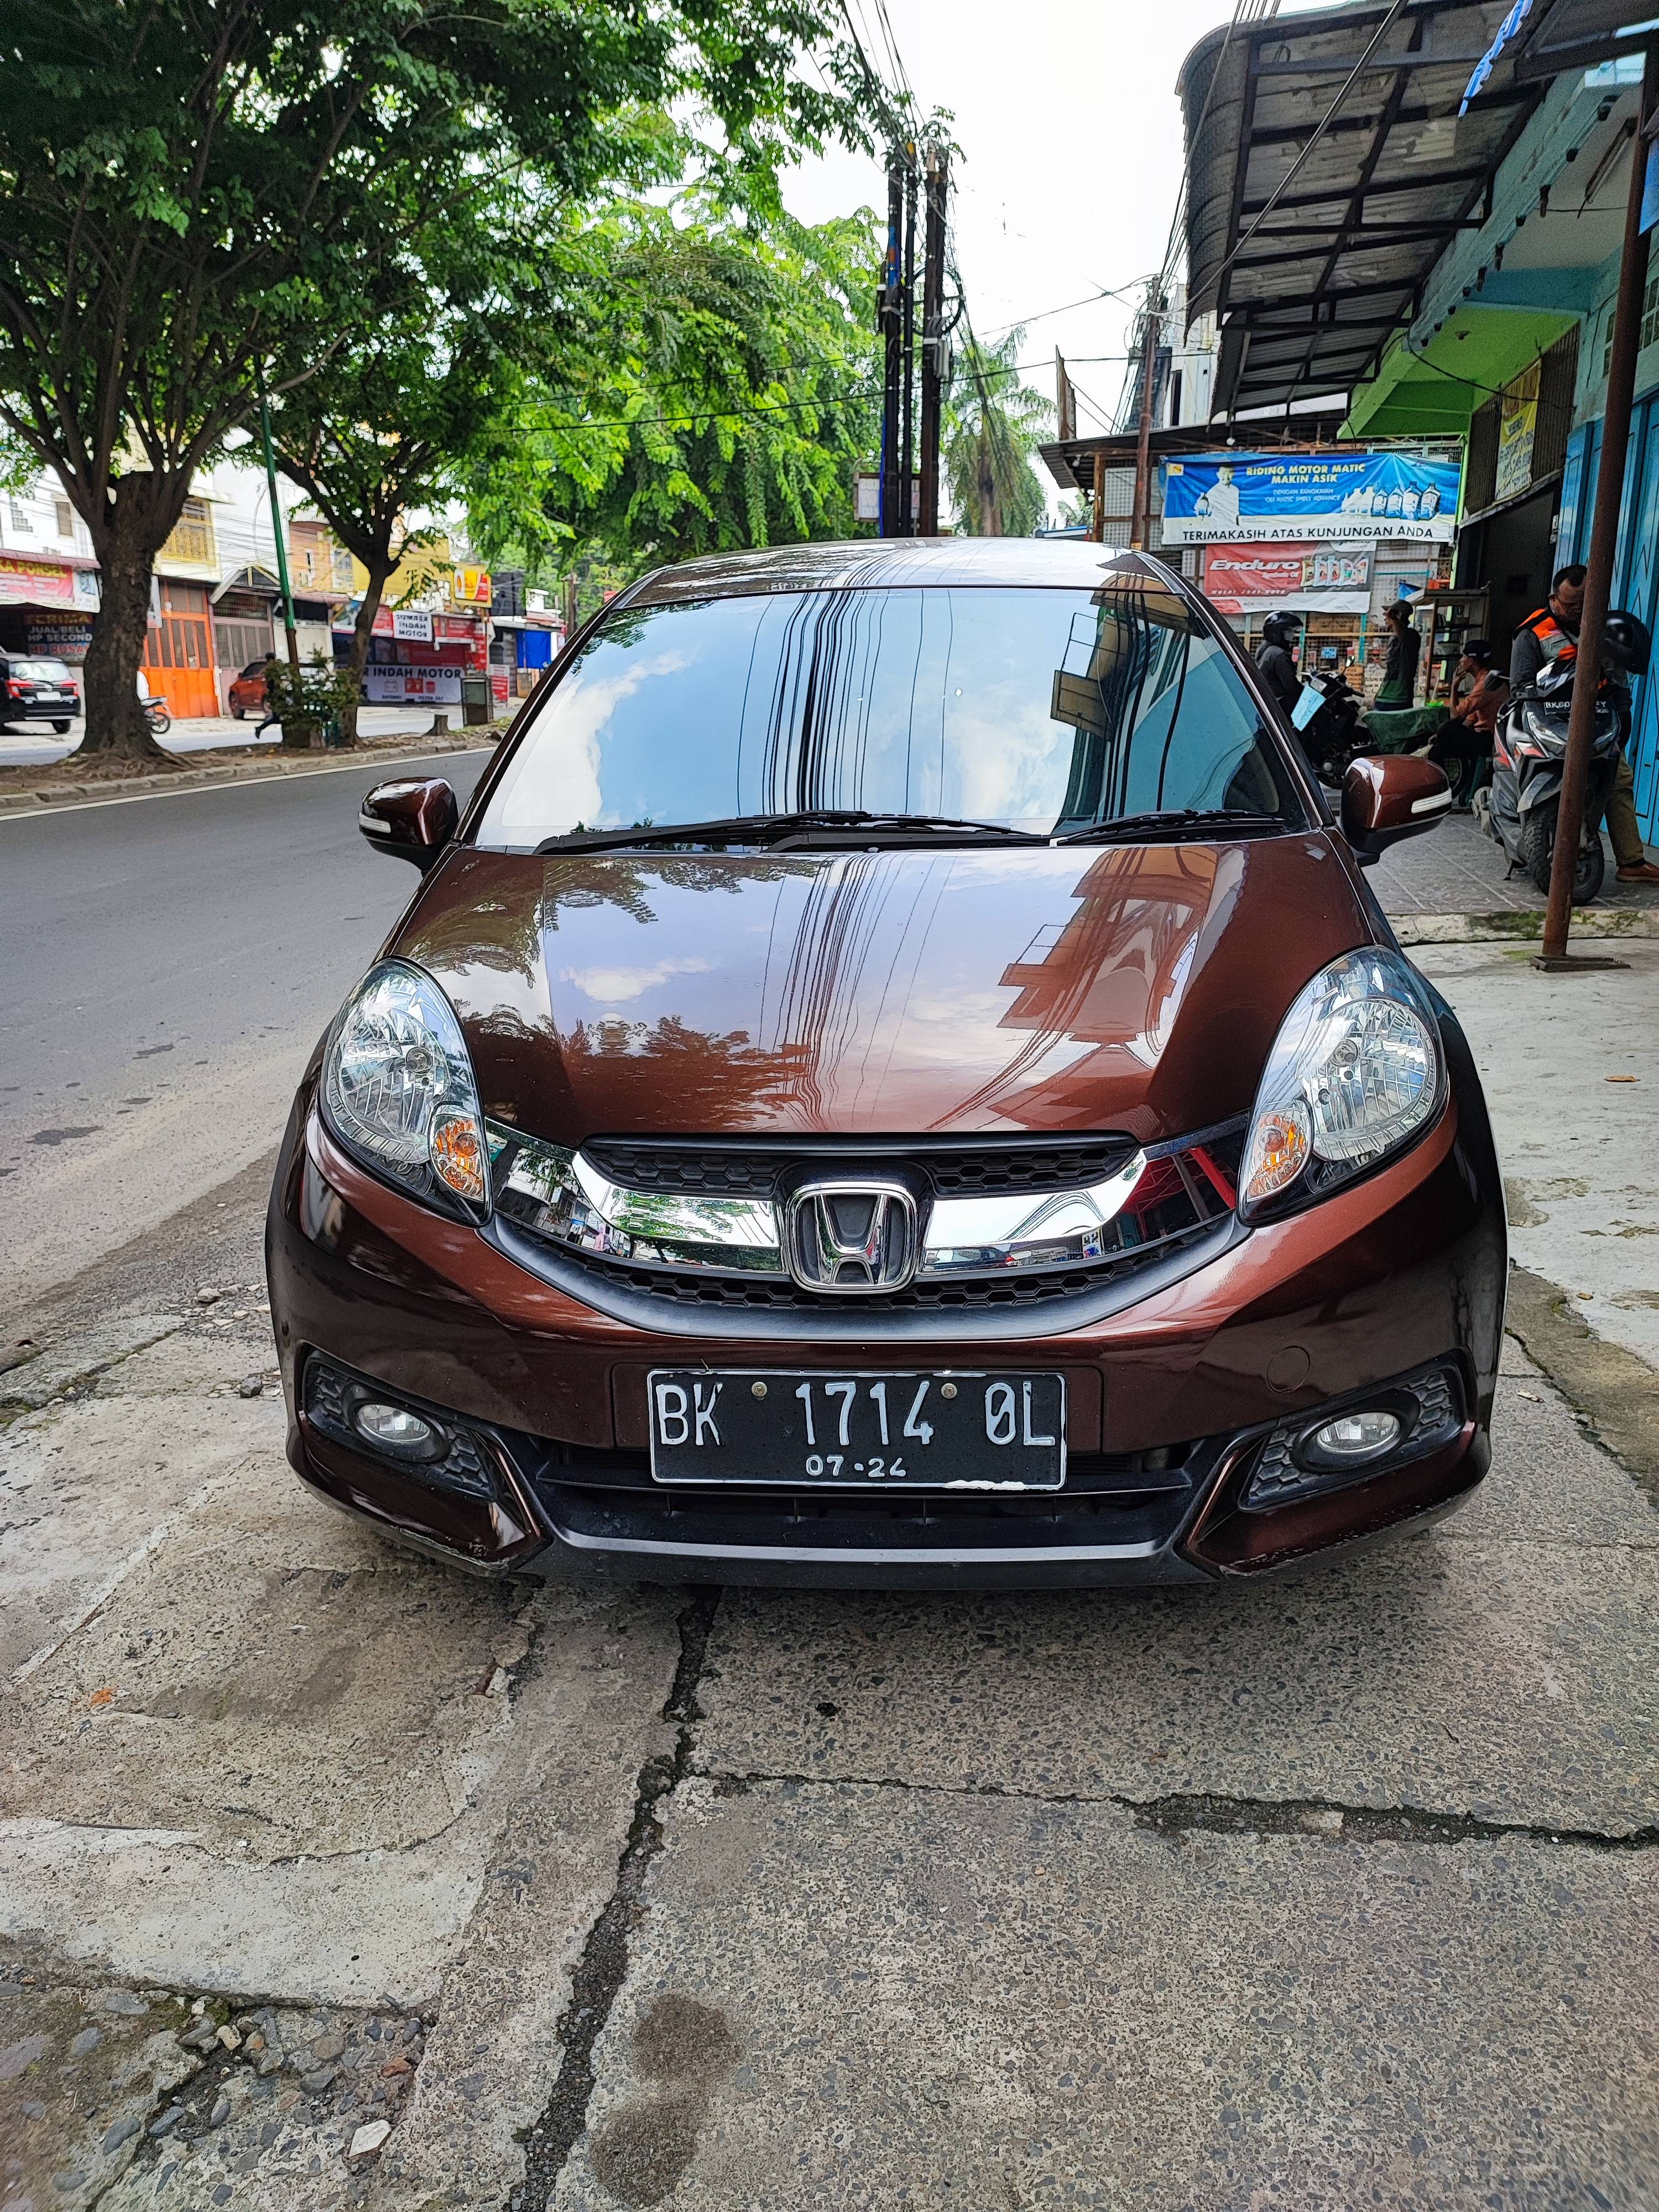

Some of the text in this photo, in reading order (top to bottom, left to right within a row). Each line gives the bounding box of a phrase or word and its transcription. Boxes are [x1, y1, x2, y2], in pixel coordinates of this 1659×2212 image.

[1246, 463, 1366, 476] RIDING MOTOR MATIC
[1271, 474, 1338, 484] MAKIN ASIK
[1183, 526, 1433, 541] TERIMAKASIH ATAS KUNJUNGAN ANDA
[1209, 559, 1301, 571] Enduro
[46, 633, 93, 642] SECOND
[373, 667, 413, 677] INDAH
[417, 668, 461, 679] MOTOR
[655, 1383, 724, 1446] BK
[795, 1381, 935, 1446] 1714
